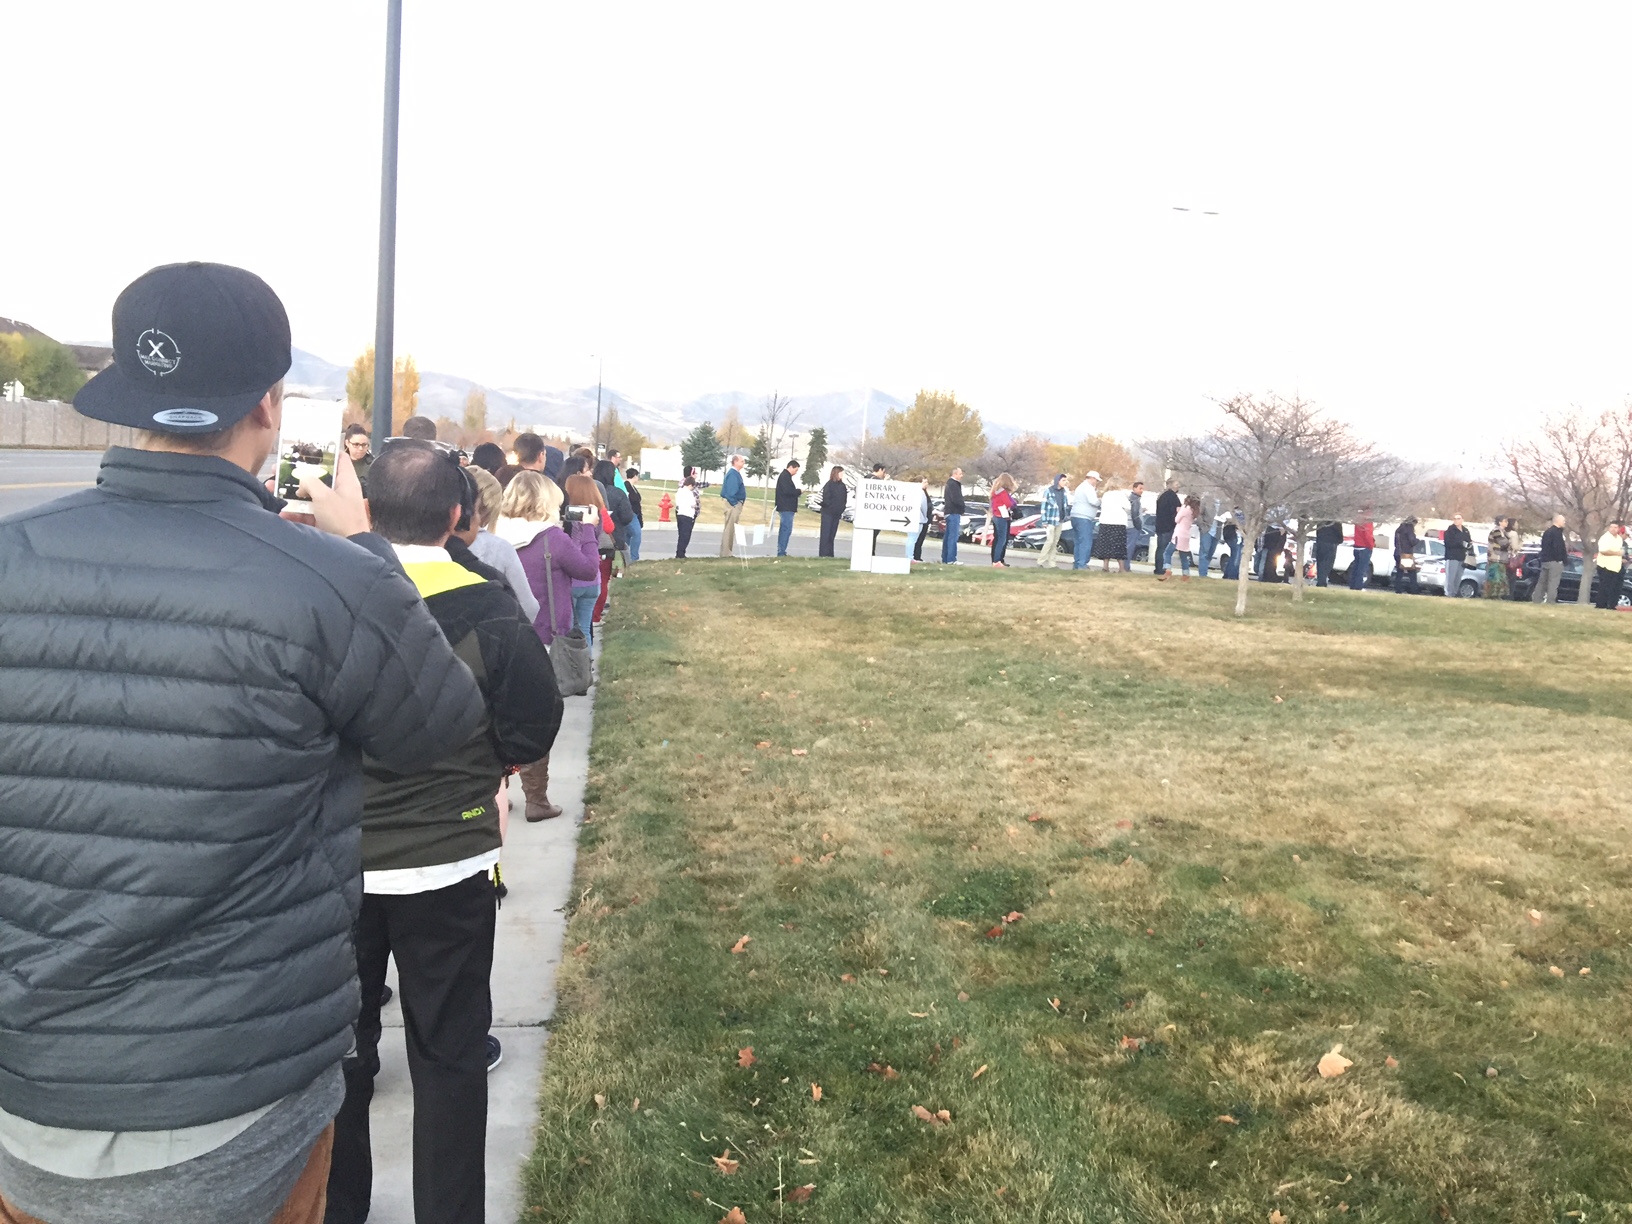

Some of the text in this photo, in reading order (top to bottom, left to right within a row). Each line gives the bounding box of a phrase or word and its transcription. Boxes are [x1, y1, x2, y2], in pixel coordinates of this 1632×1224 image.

[148, 340, 164, 358] X
[865, 483, 897, 492] LIBRARY
[865, 491, 906, 501] ENTRANCE
[864, 503, 887, 511] BOOK
